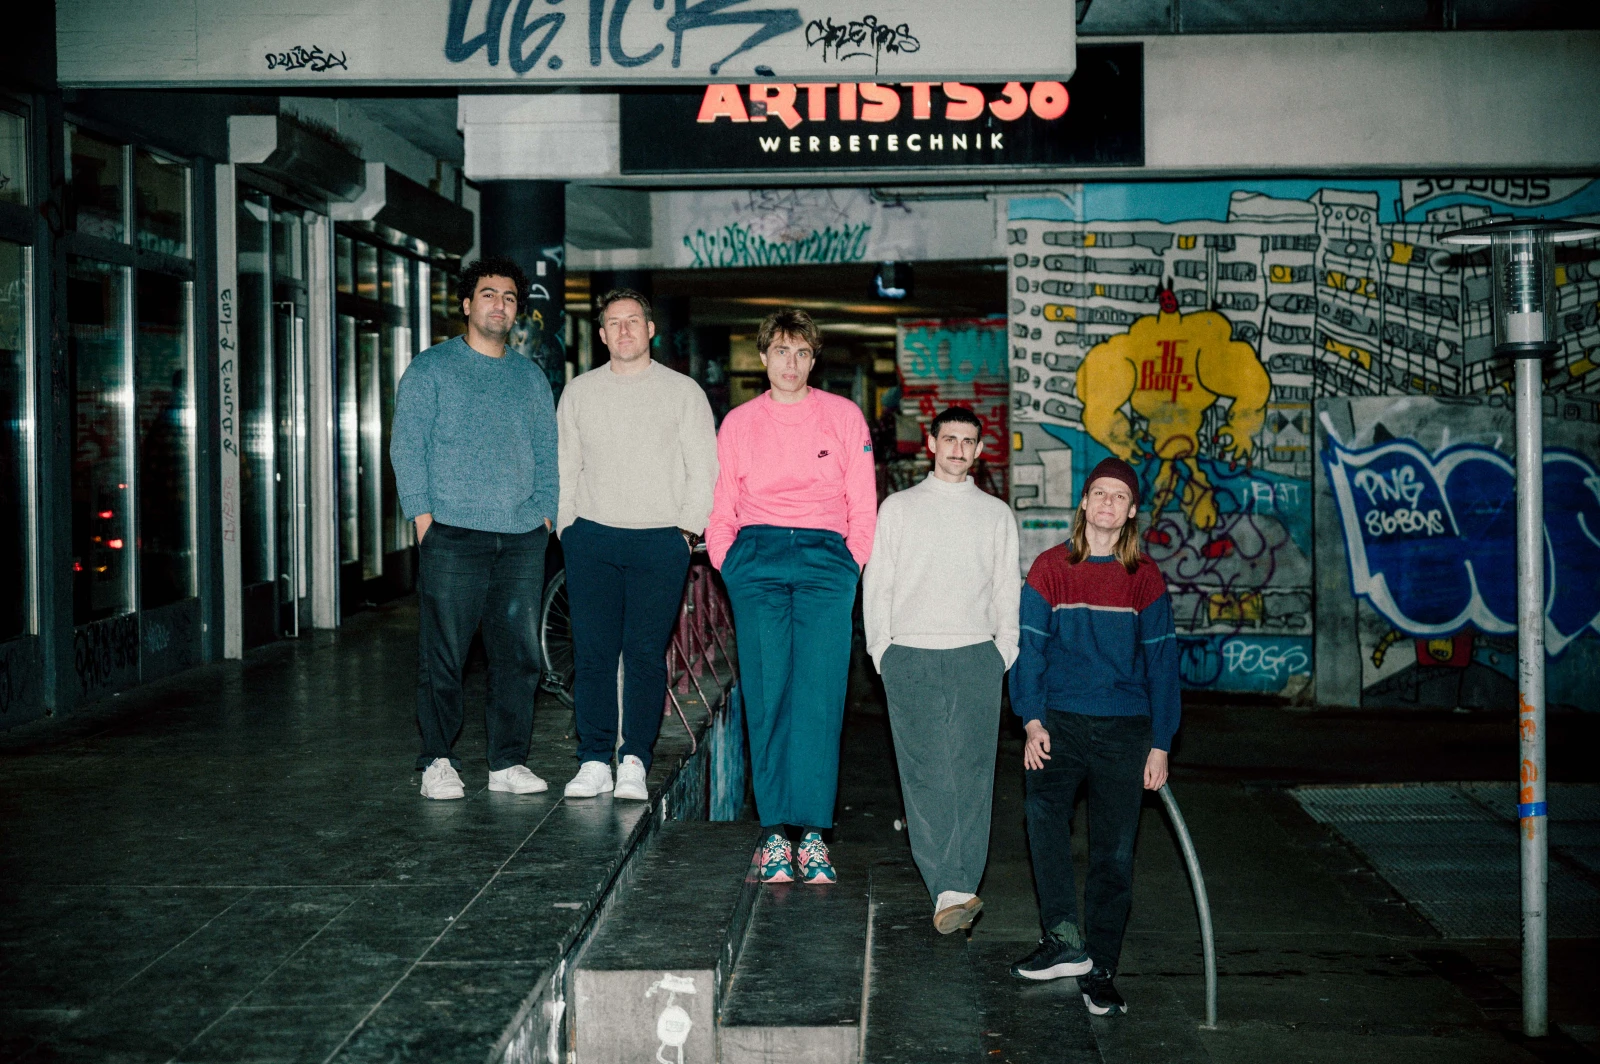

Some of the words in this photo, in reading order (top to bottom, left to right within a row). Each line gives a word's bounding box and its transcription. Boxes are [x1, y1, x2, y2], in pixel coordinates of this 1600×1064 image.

[697, 82, 985, 130] ARTISTS
[758, 133, 1004, 153] WERBETECHNIK
[1354, 464, 1425, 510] PNG
